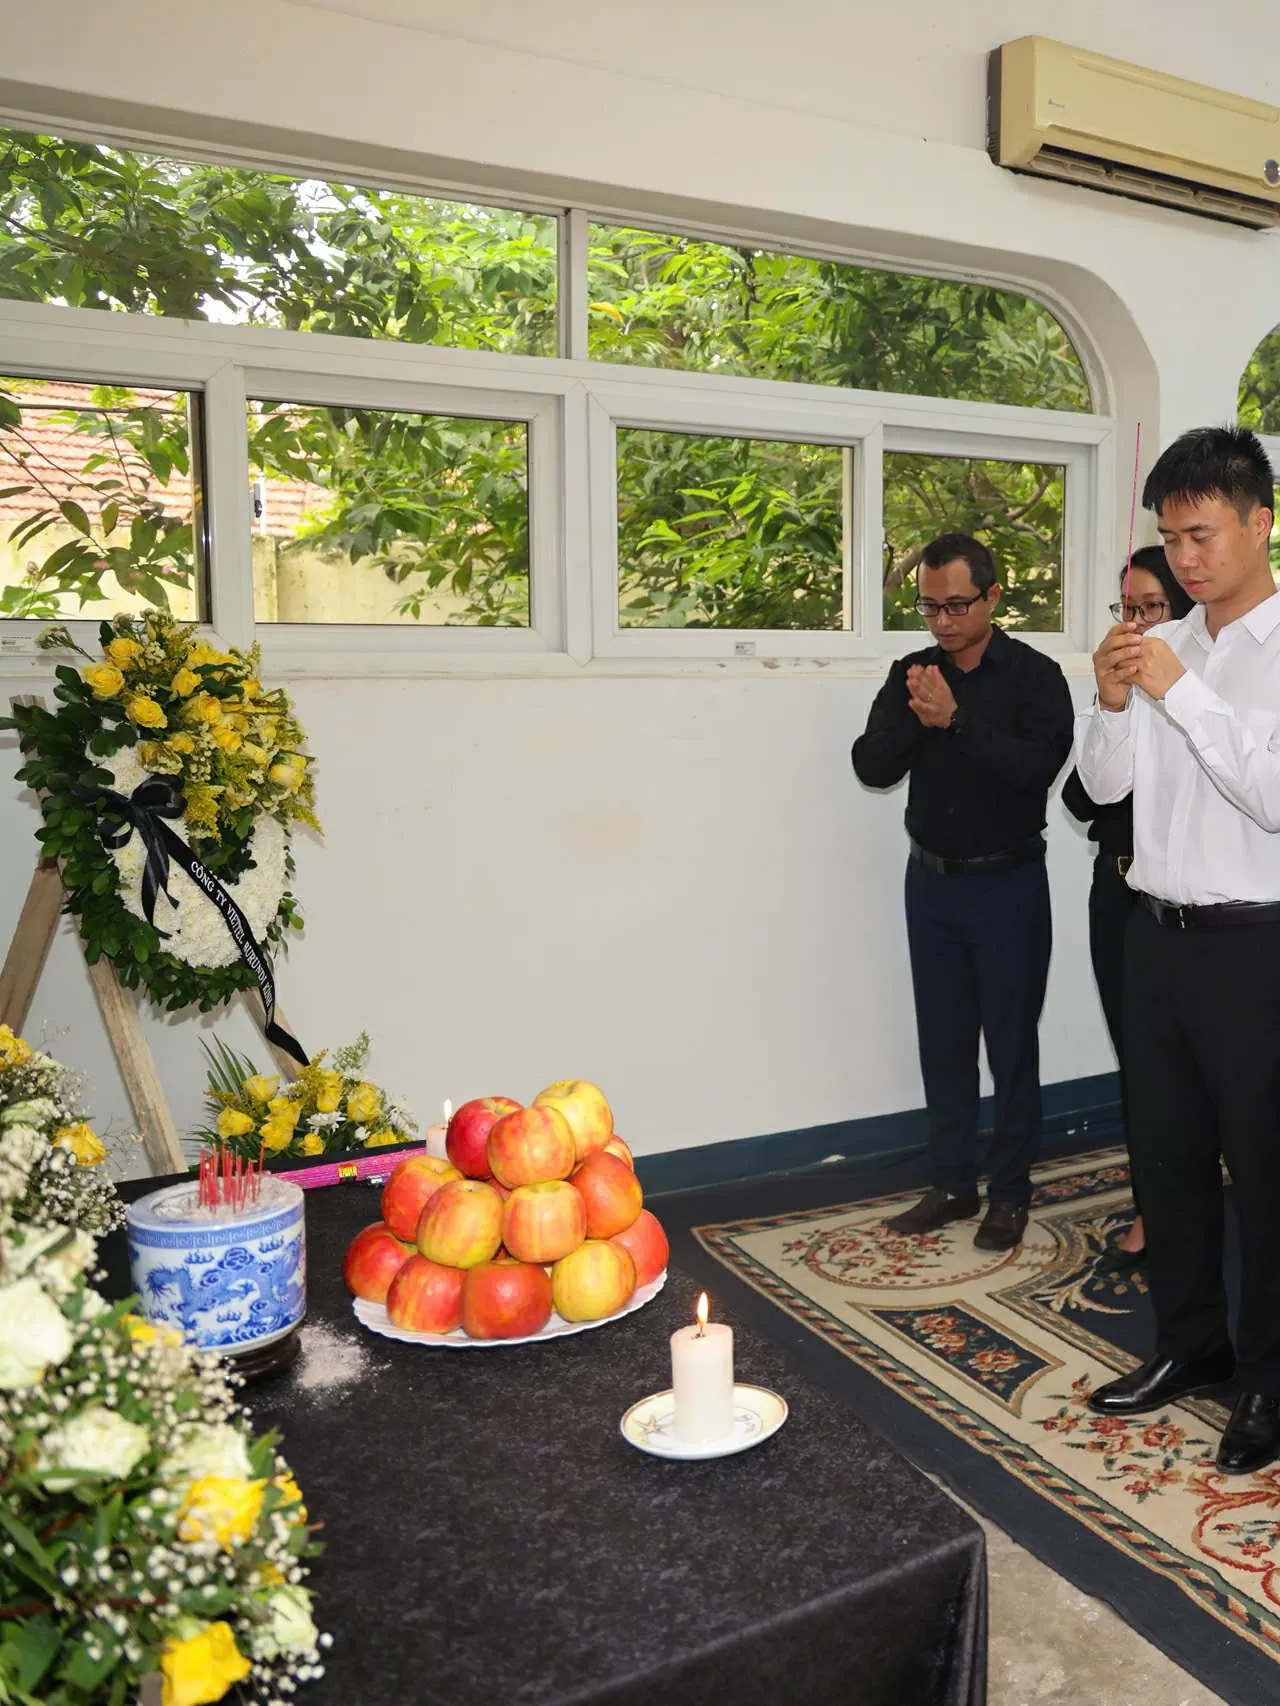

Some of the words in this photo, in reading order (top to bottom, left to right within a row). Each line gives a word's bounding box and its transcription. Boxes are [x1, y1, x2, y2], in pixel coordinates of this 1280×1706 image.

[191, 861, 215, 892] CÔNG
[216, 889, 227, 907] TY
[227, 903, 245, 944] VIETTEL
[243, 941, 268, 985] BURUNDI
